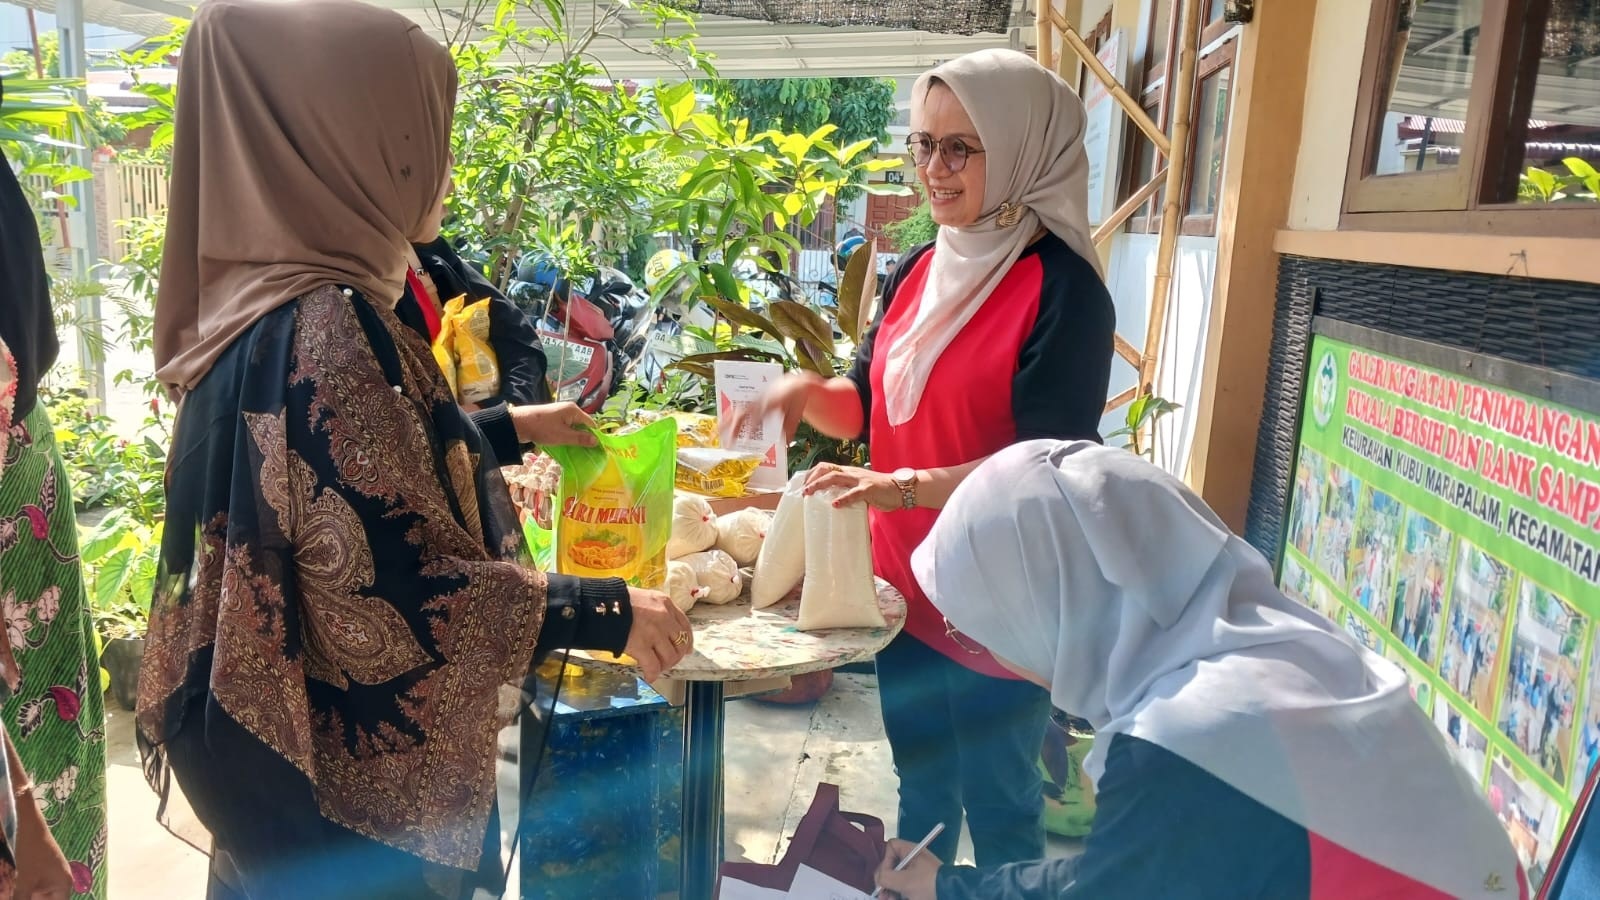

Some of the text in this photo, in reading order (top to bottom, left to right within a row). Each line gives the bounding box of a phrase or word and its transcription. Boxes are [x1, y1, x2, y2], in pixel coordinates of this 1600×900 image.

[888, 172, 900, 183] 04
[1346, 389, 1391, 433] KUMALA
[1392, 408, 1445, 455] BERSIH
[1445, 427, 1481, 471] DAN
[1482, 441, 1535, 496] BANK
[1348, 351, 1600, 467] GALERI KEGIATAN PENIMBANGAN
[1343, 426, 1393, 468] KELURAHAN
[1396, 452, 1423, 484] KUBU
[1425, 466, 1502, 534] MARAPALAM,
